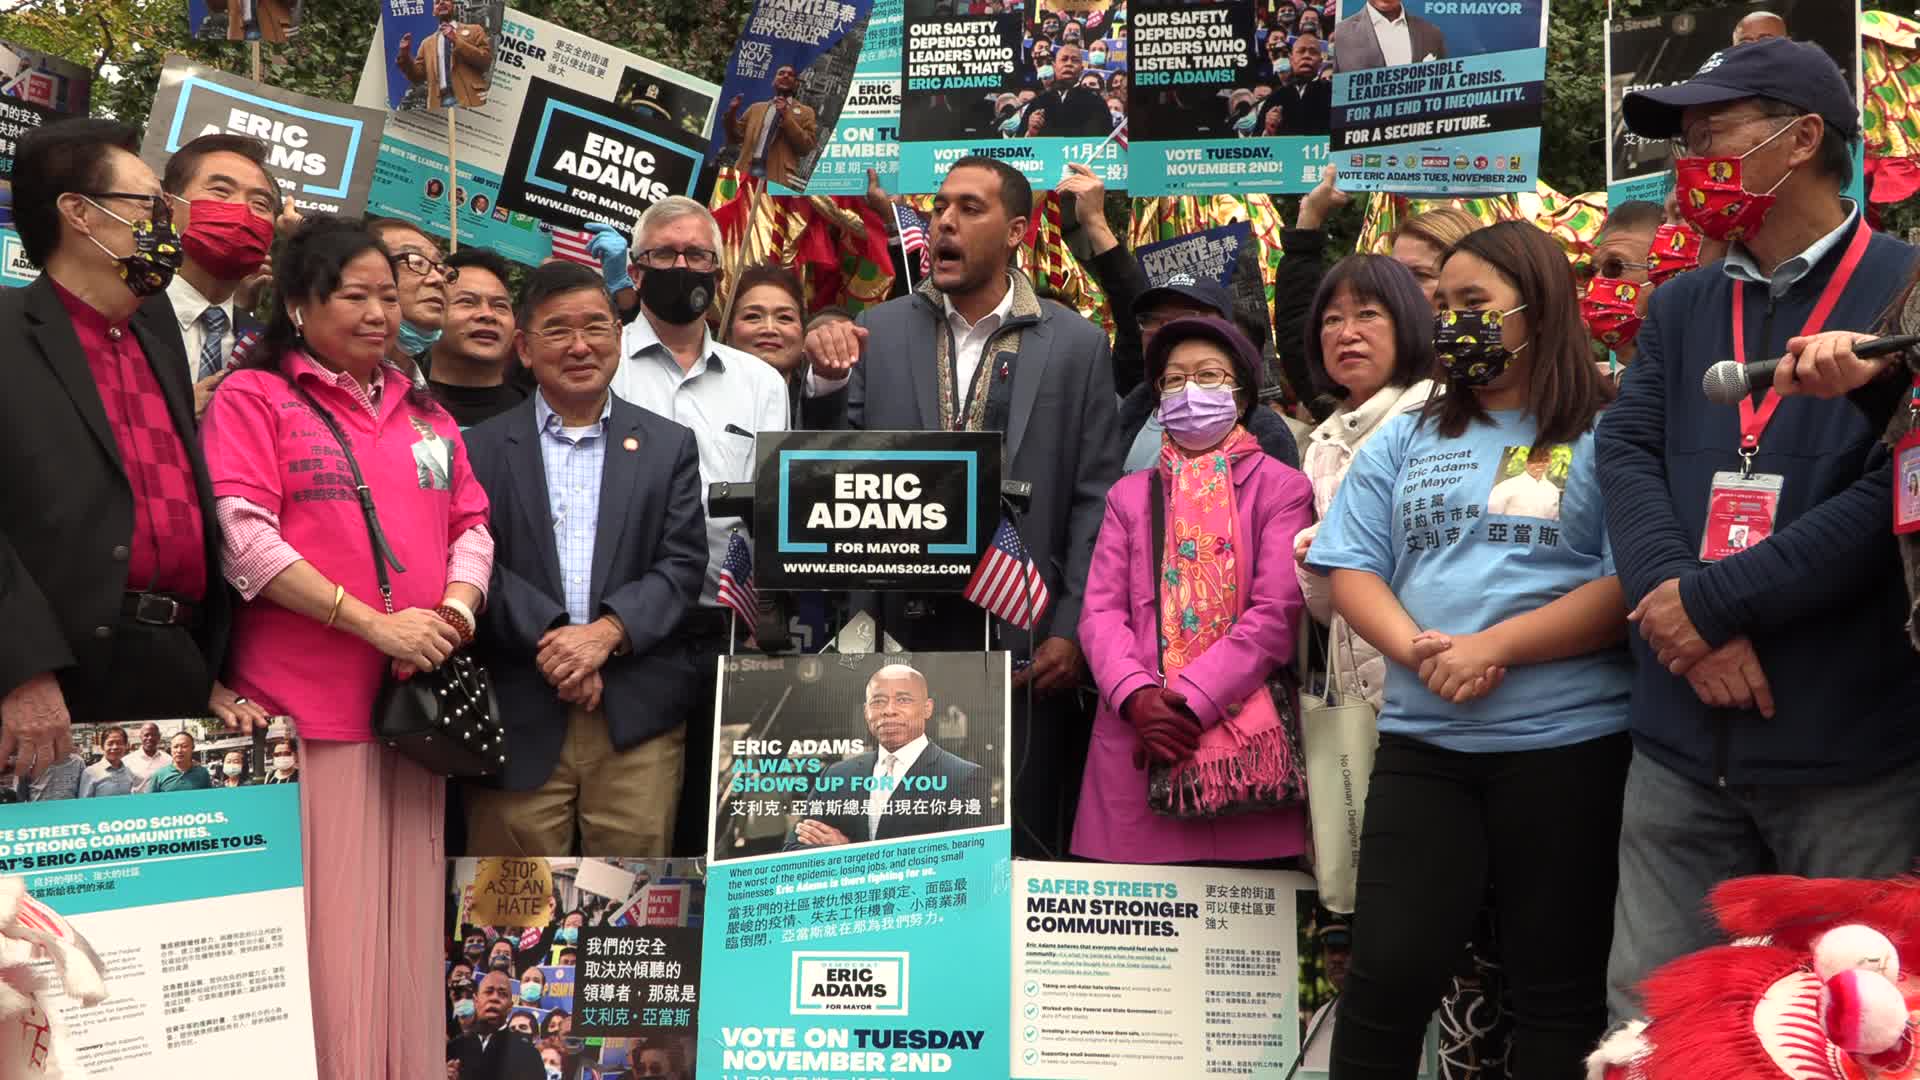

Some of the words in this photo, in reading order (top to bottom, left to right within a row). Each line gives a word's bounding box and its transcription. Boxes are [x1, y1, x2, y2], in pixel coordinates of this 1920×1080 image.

[1424, 3, 1460, 15] FOR
[1461, 2, 1522, 15] MAYOR
[752, 17, 807, 34] DEMOCRAT
[1134, 13, 1168, 27] OUR
[1170, 10, 1228, 25] SAFETY
[750, 25, 774, 37] CITY
[774, 30, 820, 45] COUNCIL
[910, 24, 942, 36] OUR
[943, 21, 998, 34] SAFETY
[1134, 26, 1206, 42] DEPENDS
[1208, 24, 1232, 38] ON
[741, 40, 772, 54] VOTE
[910, 37, 976, 50] DEPENDS
[978, 34, 1001, 47] ON
[1134, 41, 1203, 57] LEADERS
[1204, 39, 1246, 53] WHO
[739, 50, 765, 62] NOV
[909, 50, 973, 63] LEADERS
[974, 48, 1013, 61] WHO
[1134, 56, 1191, 71] LISTEN.
[1194, 54, 1248, 68] THAT'S
[909, 64, 961, 77] LISTEN.
[964, 61, 1015, 75] THAT'S
[1135, 71, 1170, 85] ERIC
[1172, 70, 1235, 84] ADAMS!
[1349, 73, 1373, 87] FOR
[1376, 60, 1464, 84] RESPONSIBLE
[859, 85, 892, 95] ERIC
[908, 77, 940, 90] ERIC
[943, 75, 1002, 89] ADAMS!
[1348, 80, 1426, 101] LEADERSHIP
[1429, 77, 1444, 91] IN
[1446, 76, 1456, 88] A
[1459, 69, 1505, 86] CRISIS.
[848, 96, 901, 106] ADAMS
[1346, 108, 1371, 122] FOR
[1374, 106, 1394, 120] AN
[1395, 100, 1421, 116] END
[1425, 98, 1442, 112] TO
[1444, 87, 1526, 110] INEQUALITY.
[227, 107, 309, 149] ERIC
[843, 127, 874, 142] ON
[1344, 130, 1369, 145] FOR
[1372, 127, 1382, 142] A
[1384, 120, 1434, 140] SECURE
[1436, 114, 1491, 134] FUTURE.
[583, 132, 656, 175] ERIC
[1165, 149, 1203, 160] VOTE
[1205, 147, 1273, 161] TUESDAY,
[553, 150, 670, 203] ADAMS
[1166, 163, 1247, 176] NOVEMBER
[1248, 161, 1283, 174] 2ND!
[1338, 171, 1361, 180] VOTE
[1363, 172, 1385, 180] ERIC
[1387, 172, 1421, 182] ADAMS
[1452, 173, 1504, 183] NOVEMBER
[1506, 173, 1527, 183] 2ND
[571, 188, 598, 204] FOR
[600, 196, 642, 219] MAYOR
[1142, 235, 1207, 262] CHRISTOPHER
[1144, 243, 1210, 278] MARTE
[1409, 449, 1472, 468] Democrat
[1407, 469, 1428, 481] Eric
[1430, 461, 1478, 474] Adams
[835, 473, 922, 500] ERIC
[1403, 484, 1417, 497] for
[1420, 475, 1463, 490] Mayor
[1402, 493, 1446, 517] 民主黨
[807, 502, 948, 530] ADAMS
[835, 543, 864, 554] FOR
[866, 543, 920, 554] MAYOR
[784, 563, 971, 575] WWW.ERICADAMS2021.COM
[740, 659, 784, 672] Street
[732, 740, 782, 756] ERIC
[788, 738, 864, 755] ADAMS
[732, 758, 821, 774] ALWAYS
[1341, 754, 1348, 768] No
[731, 777, 808, 792] SHOWS
[815, 777, 845, 792] UP
[851, 776, 895, 792] FOR
[902, 776, 947, 792] YOU
[1342, 768, 1353, 807] Ordinary
[98, 817, 148, 833] GOOD
[150, 811, 230, 829] SCHOOLS,
[1348, 809, 1357, 848] Designer
[13, 837, 88, 856] STRONG
[90, 826, 211, 847] COMMUNITIES.
[37, 852, 77, 867] ERIC
[147, 838, 219, 856] PROMISE
[220, 836, 242, 849] TO
[243, 834, 267, 846] US.
[730, 868, 752, 878] When
[754, 866, 769, 875] our
[771, 856, 825, 873] communities
[827, 856, 841, 865] are
[844, 851, 880, 865] targeted
[882, 848, 894, 858] for
[897, 847, 916, 857] hate
[952, 838, 985, 849] bearing
[500, 861, 538, 880] STOP
[729, 880, 742, 890] the
[744, 877, 768, 888] worst
[770, 875, 779, 885] of
[781, 873, 795, 883] the
[840, 863, 866, 877] losing
[890, 859, 906, 868] and
[908, 855, 938, 867] closing
[941, 850, 964, 862] small
[484, 879, 545, 896] ASIAN
[727, 887, 774, 901] businesses
[776, 884, 794, 896] Eric
[796, 880, 828, 893] Adams
[830, 878, 839, 888] is
[867, 869, 904, 884] fighting
[1027, 878, 1090, 897] SAFER
[1093, 879, 1178, 899] STREETS
[1205, 884, 1276, 900] 更安全的街道
[496, 897, 544, 916] HATE
[1026, 897, 1087, 914] MEAN
[1089, 899, 1199, 919] STRONGER
[1205, 901, 1276, 916] 可以使社區更
[1026, 916, 1179, 937] COMMUNITIES.
[1205, 918, 1229, 930] 強大
[586, 937, 667, 957] 我們的安全
[583, 960, 681, 980] 取決於傾聽的
[826, 968, 873, 982] ERIC
[811, 983, 887, 998] ADAMS
[721, 1027, 796, 1048] VOTE
[804, 1028, 849, 1049] ON
[854, 1029, 985, 1050] TUESDAY
[723, 1051, 886, 1072] NOVEMBER
[890, 1052, 952, 1073] 2ND
